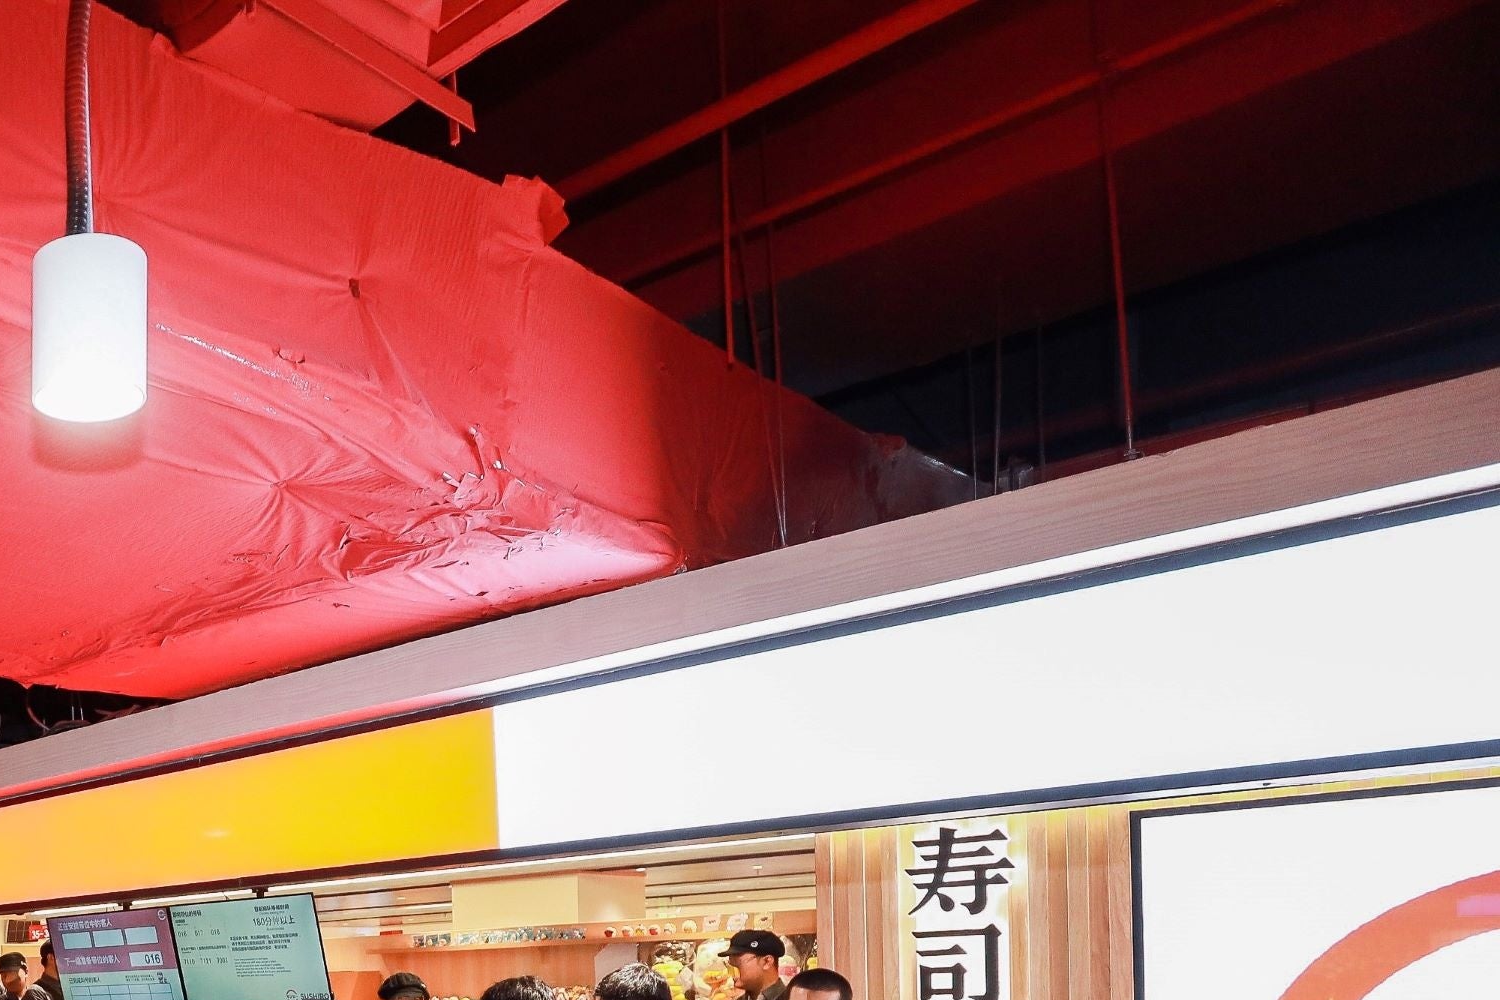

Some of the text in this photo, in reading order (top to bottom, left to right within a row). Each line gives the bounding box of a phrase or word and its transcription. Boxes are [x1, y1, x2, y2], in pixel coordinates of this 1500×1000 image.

[31, 929, 50, 940] 35-3
[144, 953, 161, 965] 016
[300, 993, 330, 1000] SUSHIRO
